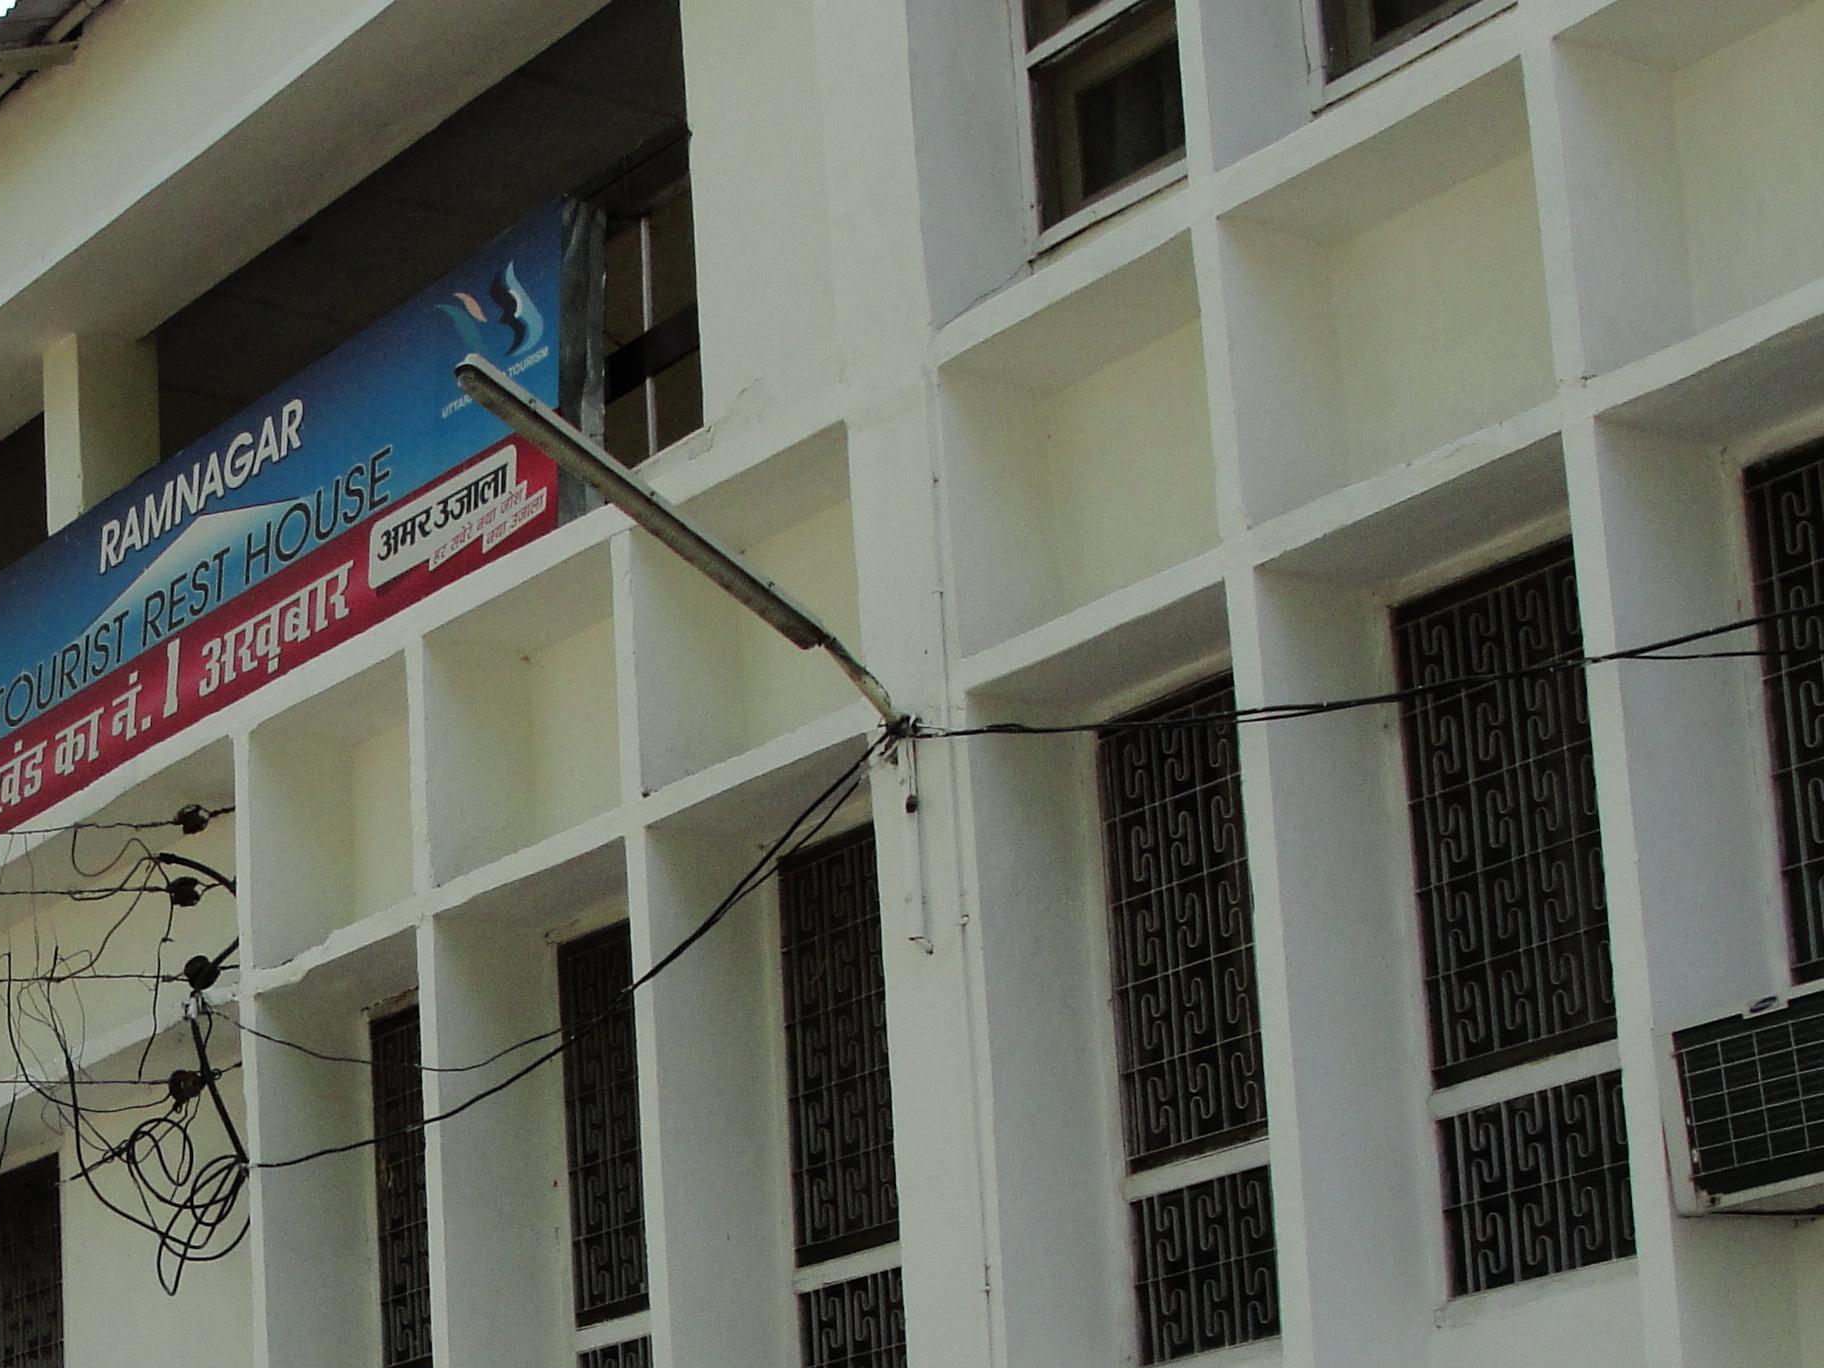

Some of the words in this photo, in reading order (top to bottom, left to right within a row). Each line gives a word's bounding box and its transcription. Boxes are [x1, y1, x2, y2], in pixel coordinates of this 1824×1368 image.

[99, 399, 304, 575] RAMNAGAR
[141, 546, 231, 648] REST
[243, 444, 392, 586] HOUSE
[54, 707, 105, 776] का
